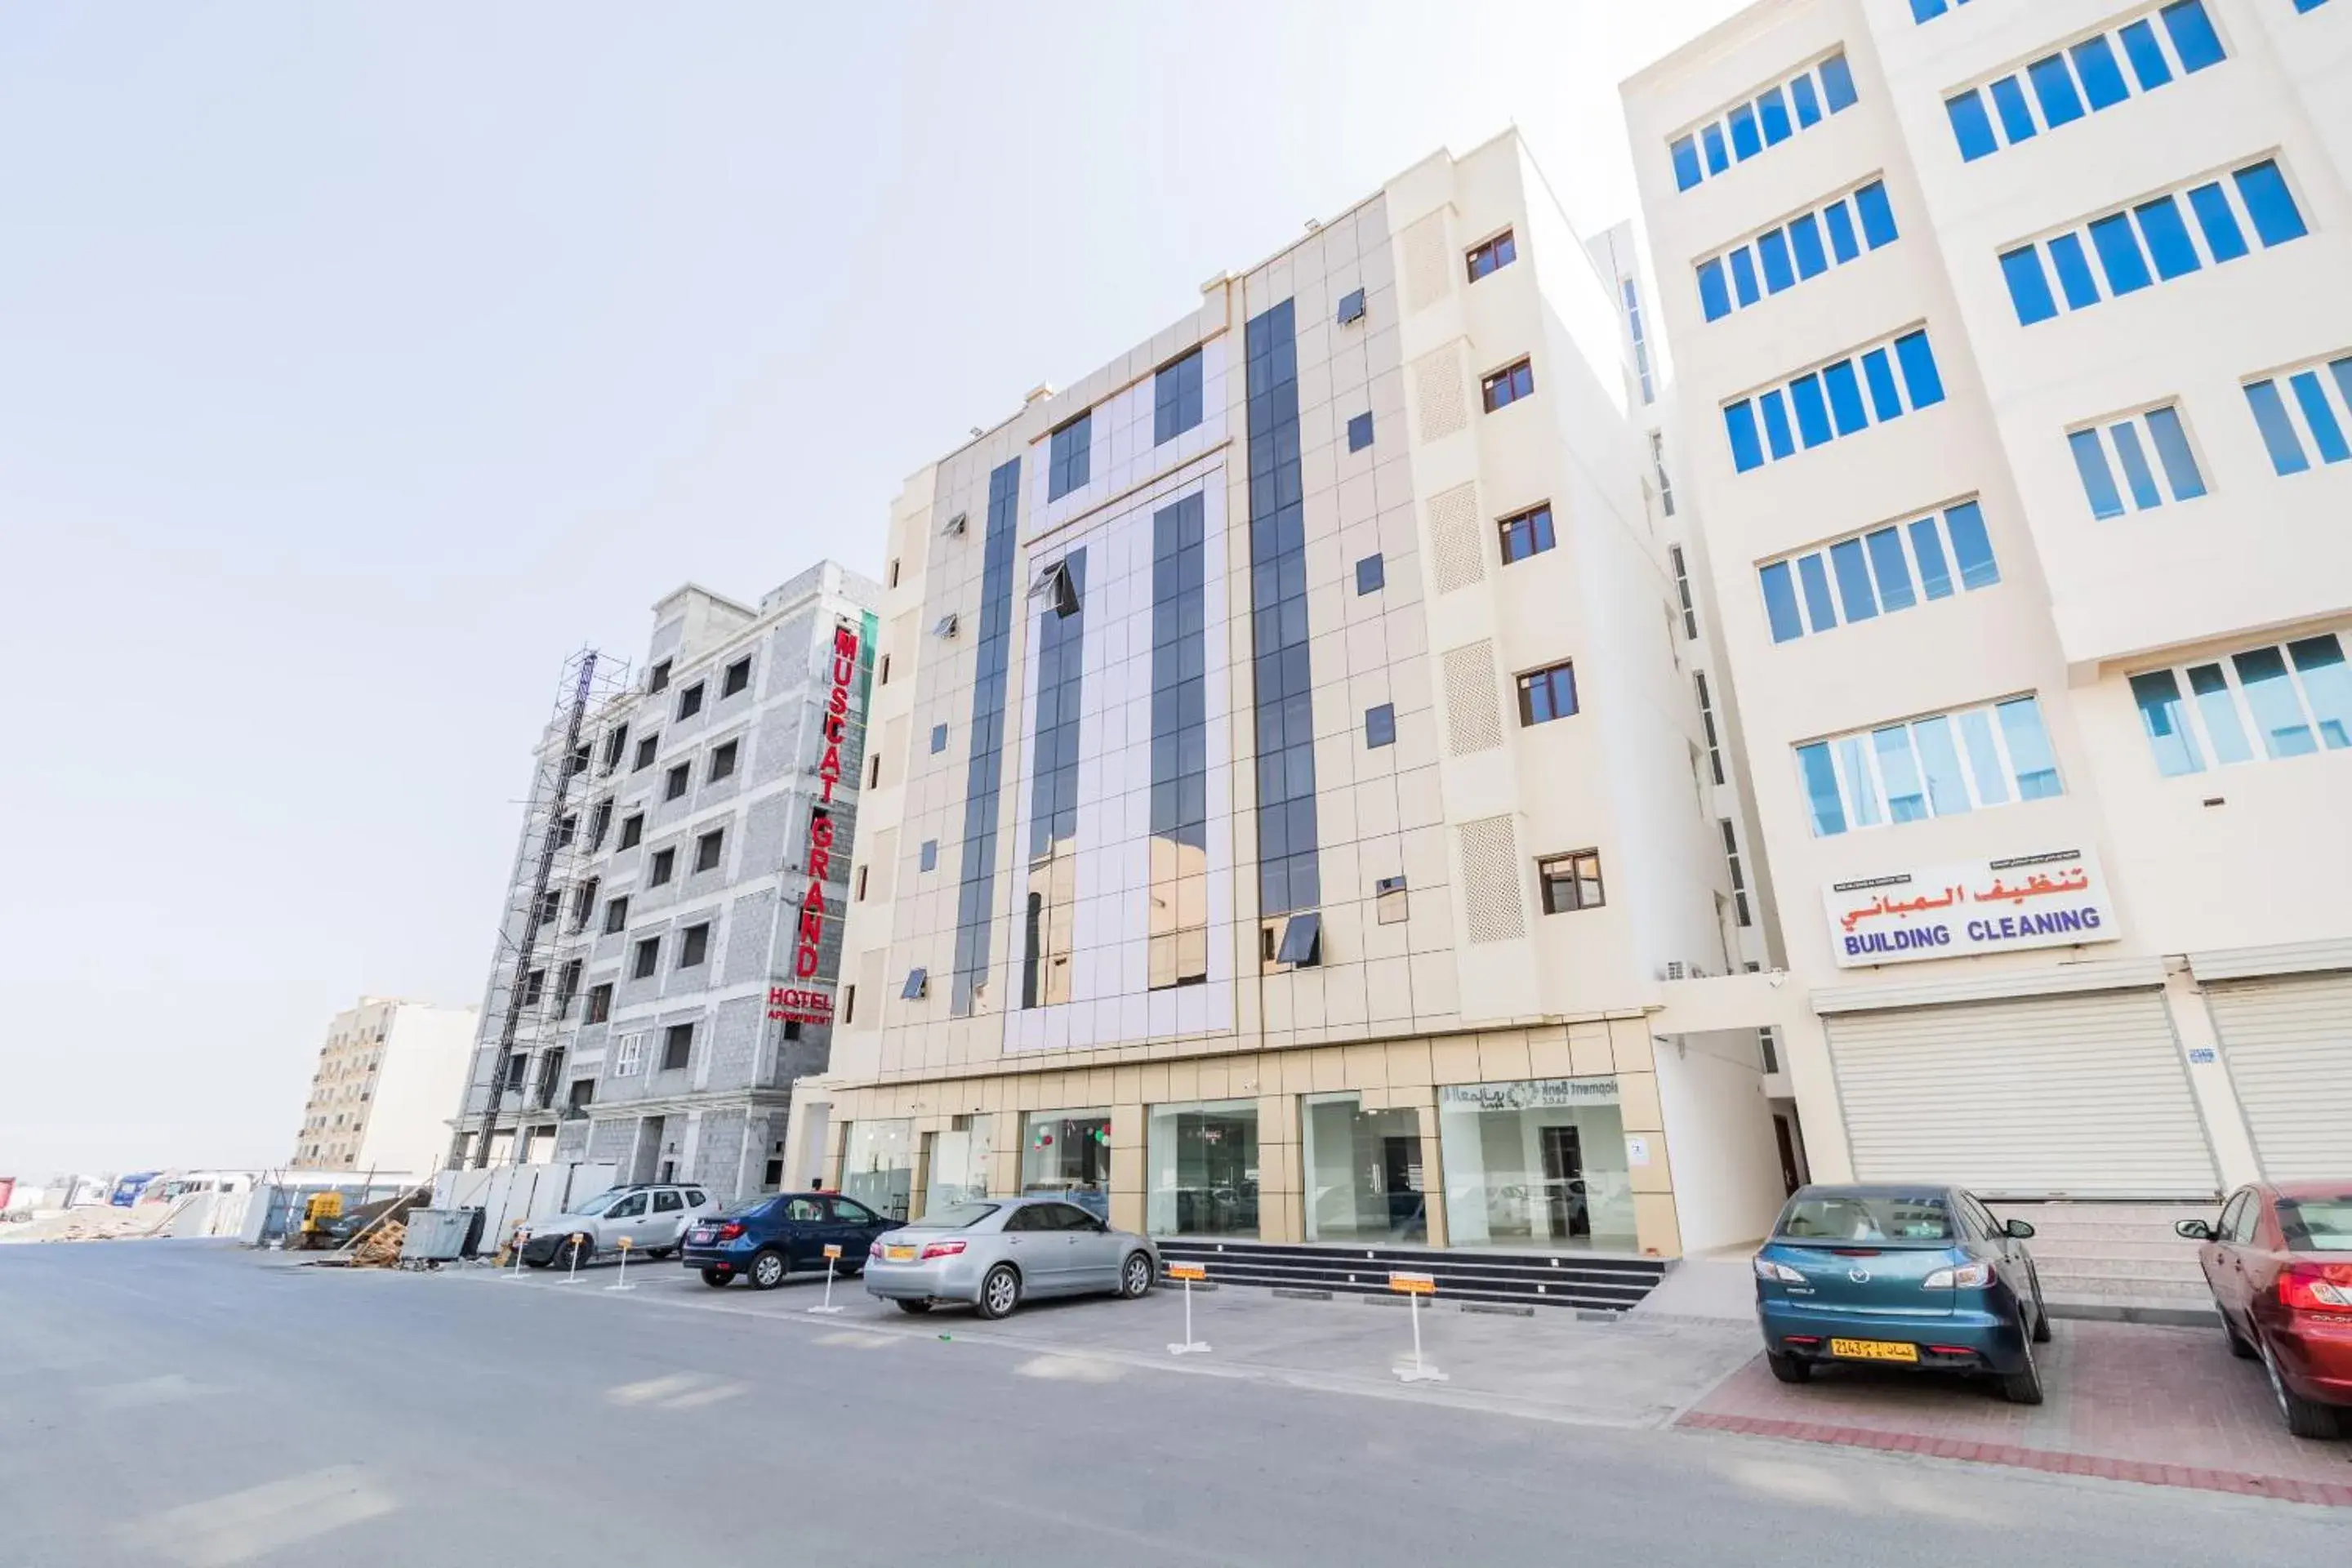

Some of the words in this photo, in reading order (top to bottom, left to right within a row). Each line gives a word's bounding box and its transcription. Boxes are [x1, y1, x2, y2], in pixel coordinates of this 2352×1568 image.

[820, 626, 859, 804] MUSCAT
[795, 817, 835, 978] GRAND
[1840, 884, 1964, 932] المباني
[1974, 867, 2088, 905] تنظيف
[1844, 925, 1950, 956] BUILDING
[1967, 906, 2100, 942] CLEANING
[769, 987, 832, 1011] HOTEL
